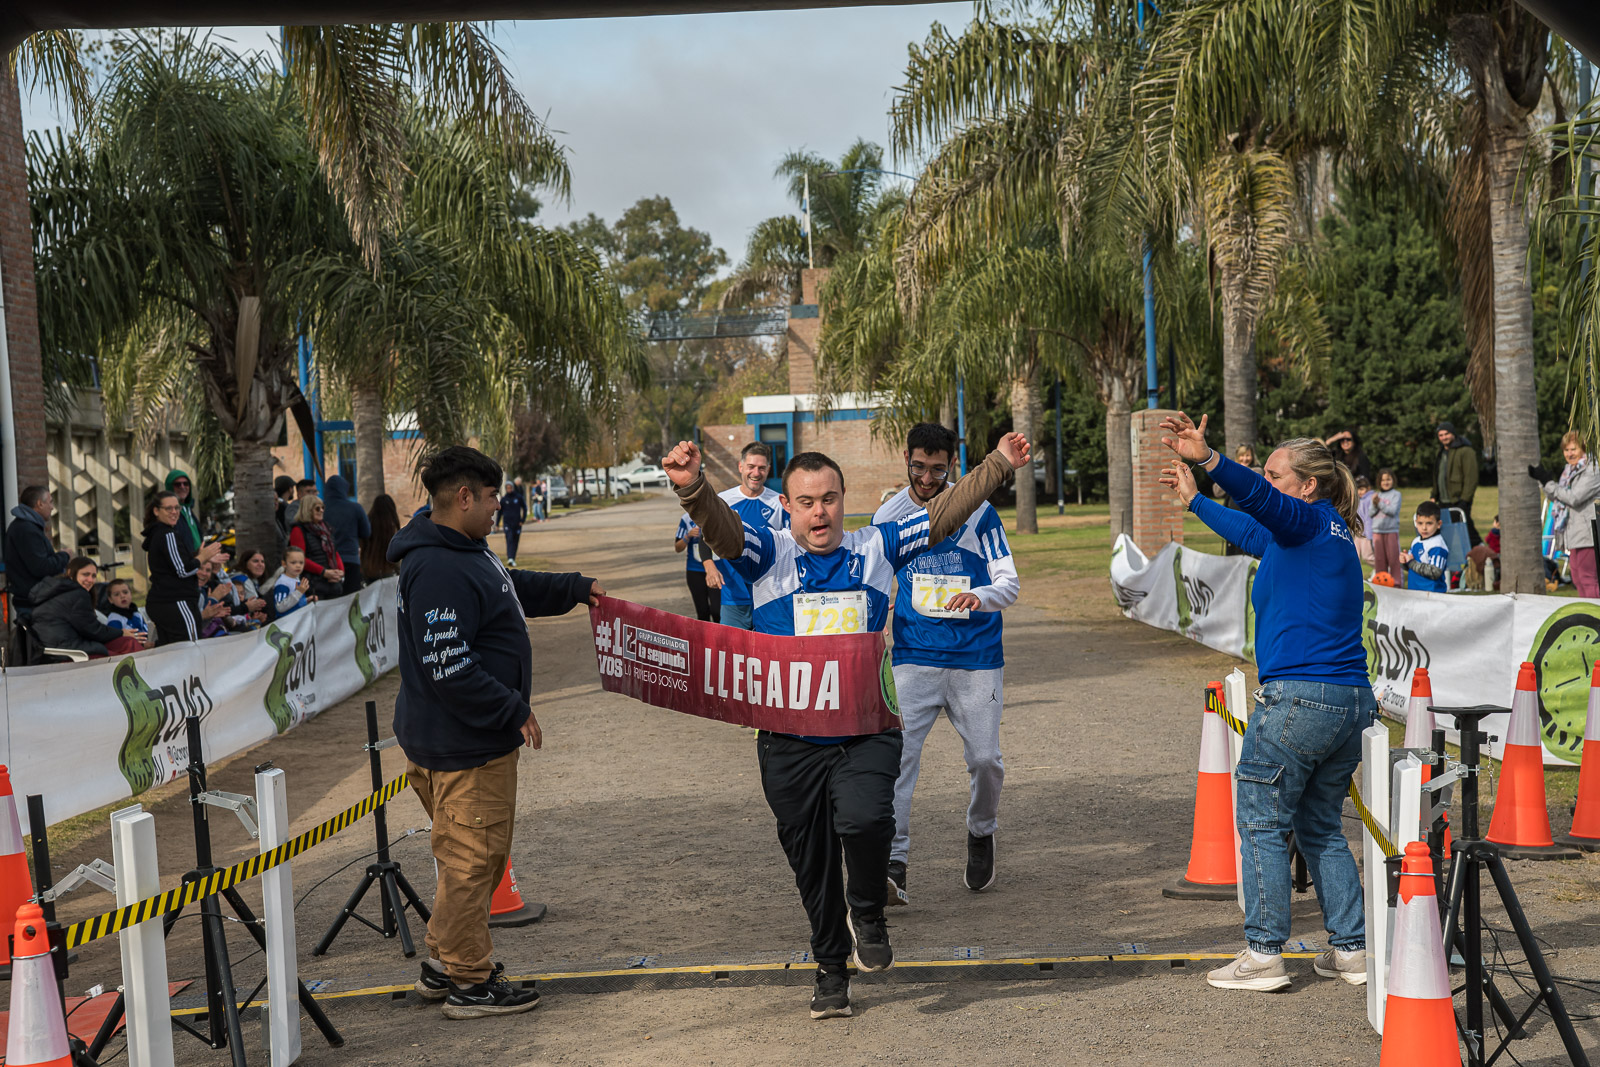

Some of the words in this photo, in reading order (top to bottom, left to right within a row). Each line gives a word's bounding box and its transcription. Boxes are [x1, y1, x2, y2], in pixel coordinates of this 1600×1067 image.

[425, 608, 439, 625] El
[440, 607, 457, 622] club
[802, 607, 860, 635] 728
[424, 628, 433, 643] de
[433, 626, 459, 648] puebl
[596, 617, 623, 656] #1
[422, 651, 439, 665] más
[598, 654, 623, 678] VOS
[638, 642, 646, 659] la
[647, 647, 686, 670] segunda
[433, 665, 444, 682] del
[703, 647, 840, 711] LLEGADA
